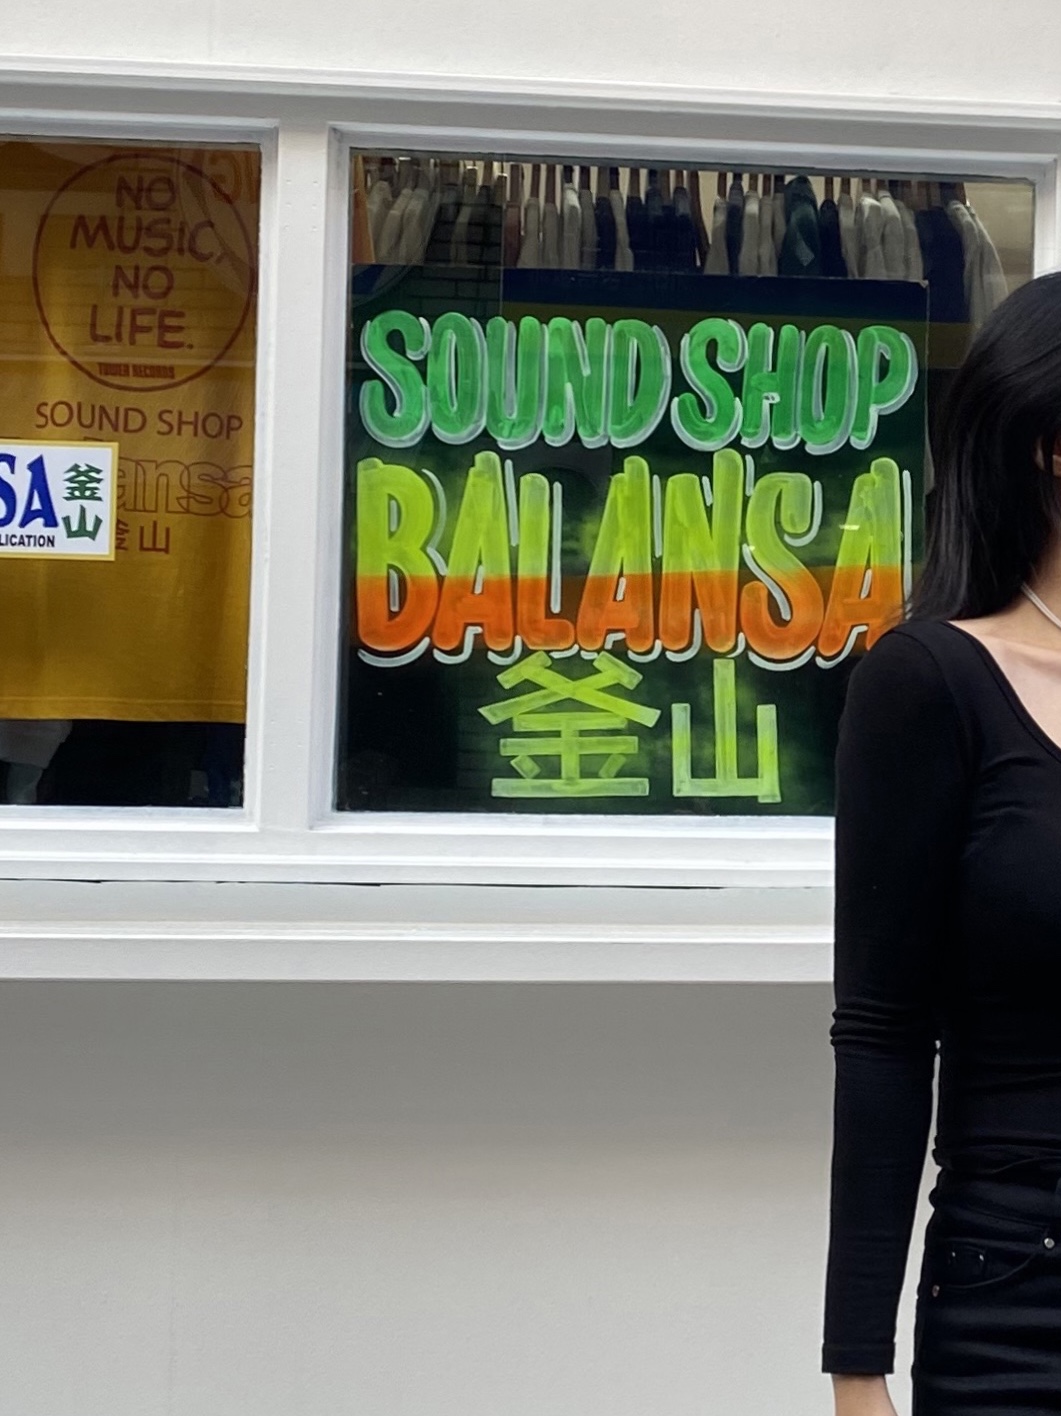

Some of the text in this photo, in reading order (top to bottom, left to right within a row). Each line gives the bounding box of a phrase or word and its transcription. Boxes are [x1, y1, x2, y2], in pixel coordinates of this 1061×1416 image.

[116, 175, 176, 211] NO
[112, 264, 174, 300] NO
[132, 363, 175, 379] RECORDS
[360, 310, 919, 454] SOUND SHOP
[35, 400, 244, 439] SOUND SHOP
[357, 448, 914, 670] BALANSA
[478, 651, 781, 803] 釜山
